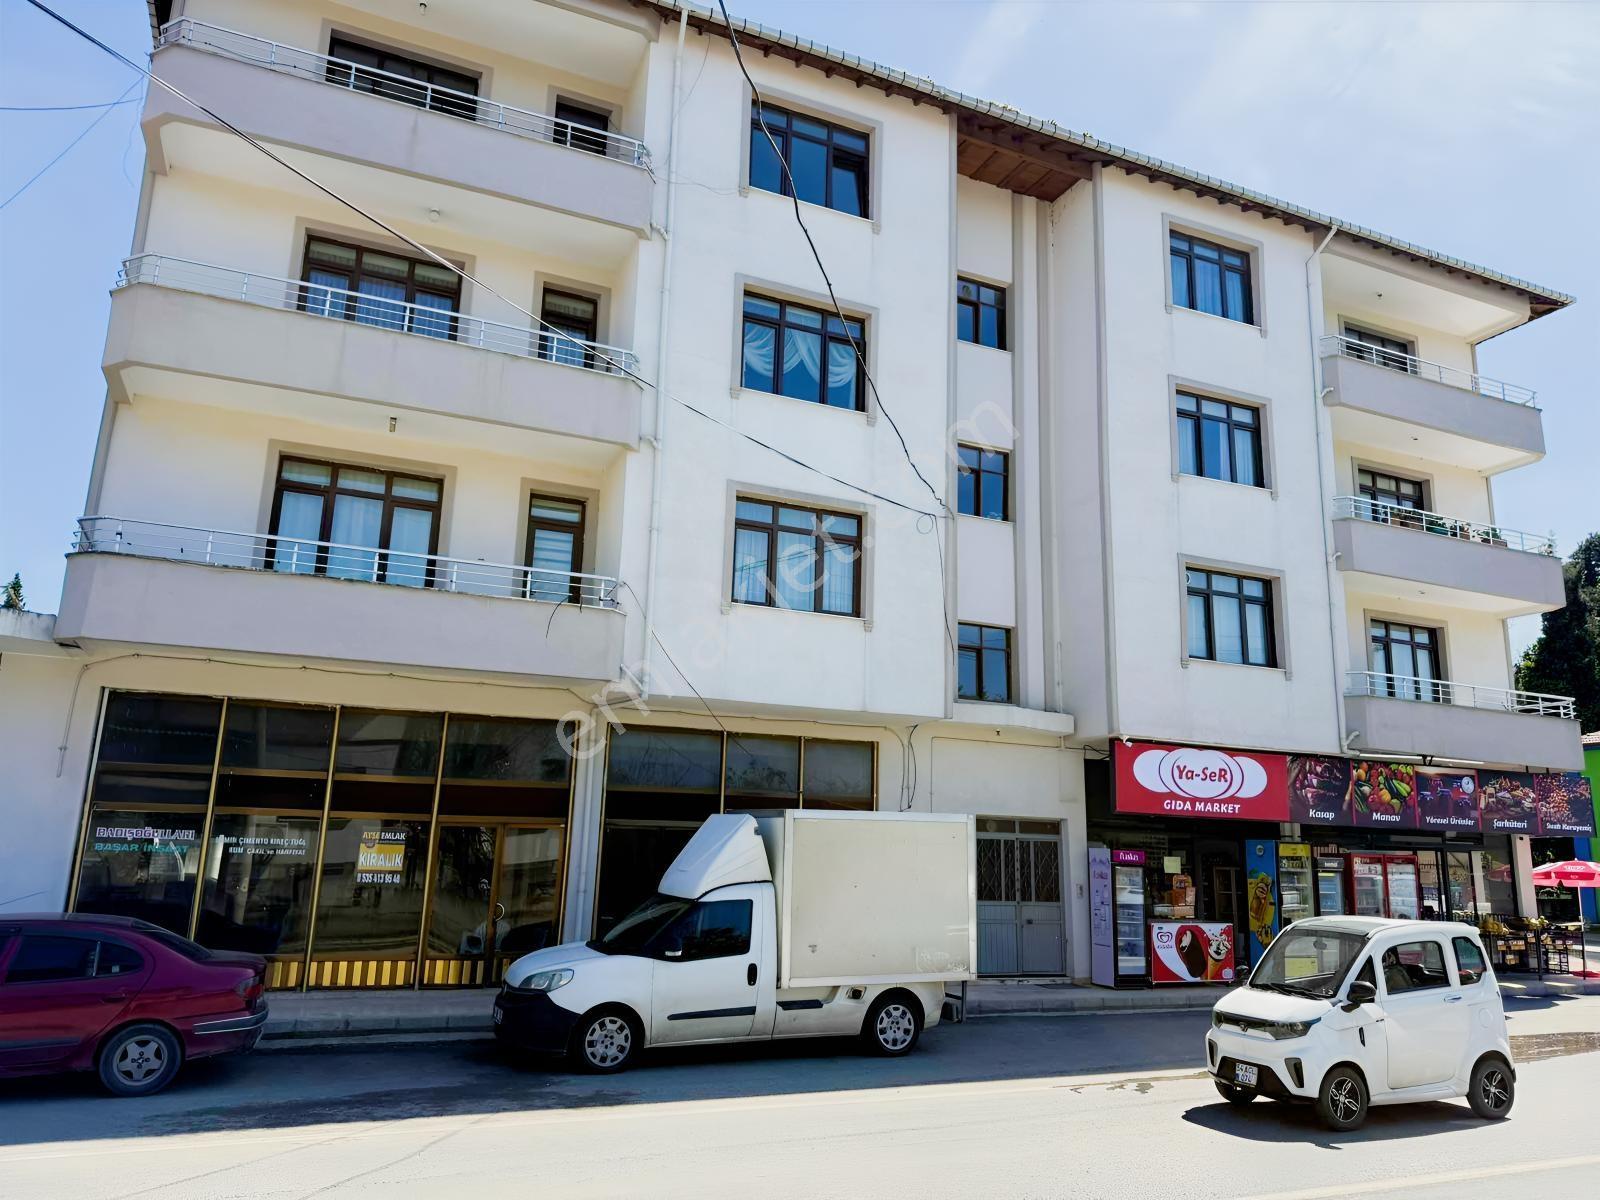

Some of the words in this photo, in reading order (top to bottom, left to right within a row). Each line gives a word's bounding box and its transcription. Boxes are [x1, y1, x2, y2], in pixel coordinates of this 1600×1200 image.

[1176, 764, 1229, 783] Ya-SeR
[1163, 799, 1192, 811] GIDA
[1195, 801, 1241, 814] MARKET
[1309, 809, 1335, 820] Kasap
[1372, 812, 1401, 822] Manav
[381, 832, 406, 840] EMLAK
